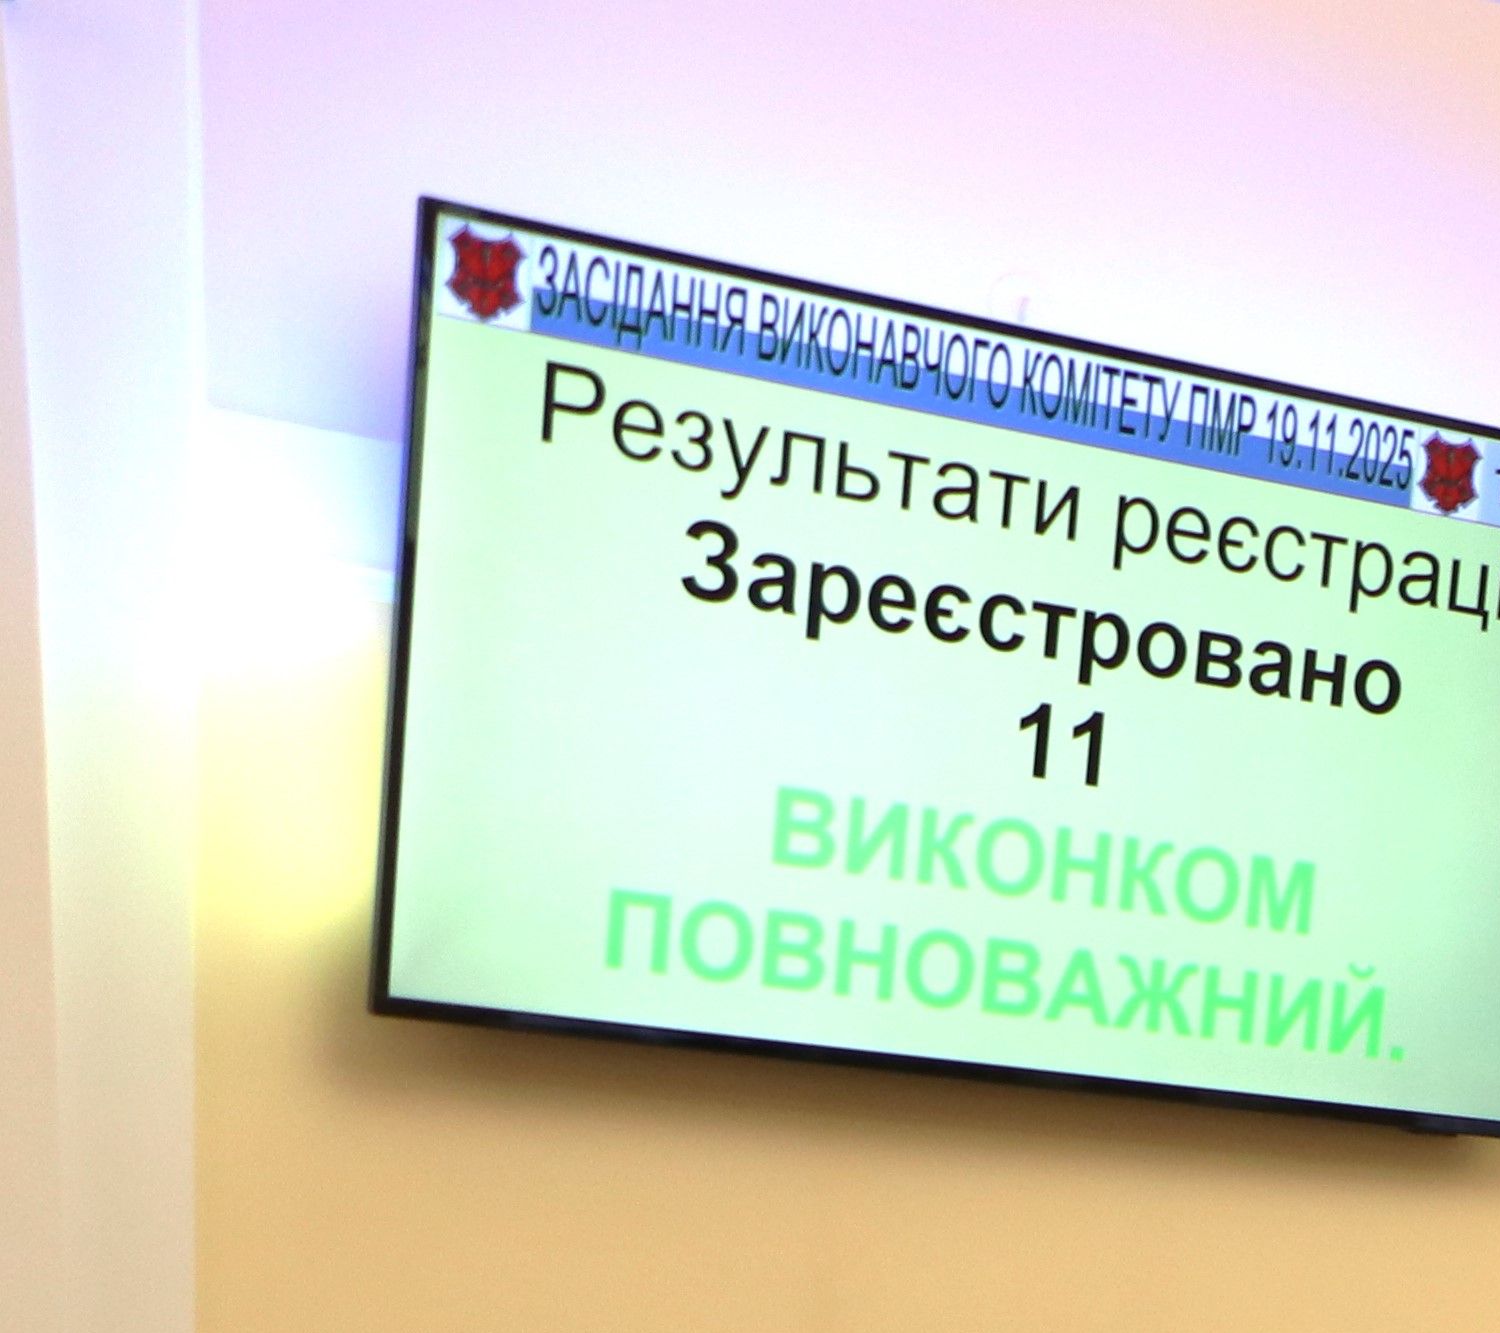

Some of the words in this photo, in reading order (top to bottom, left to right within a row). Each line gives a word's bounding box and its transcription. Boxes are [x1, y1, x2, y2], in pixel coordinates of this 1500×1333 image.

[536, 244, 748, 356] ЗАСІДАННЯ
[757, 292, 1012, 409] ВИКОНАВЧОГО
[1019, 346, 1183, 444] КОМІТЕТУ
[1185, 383, 1258, 460] ПМР
[1266, 398, 1417, 491] 19.11.2025
[540, 359, 1081, 542] Результати
[680, 519, 1403, 716] Зареєстровано
[1018, 701, 1106, 788] 11
[771, 785, 1318, 937] ВИКОНКОМ
[603, 887, 1409, 1064] ПОВНОВАЖНИЙ.
